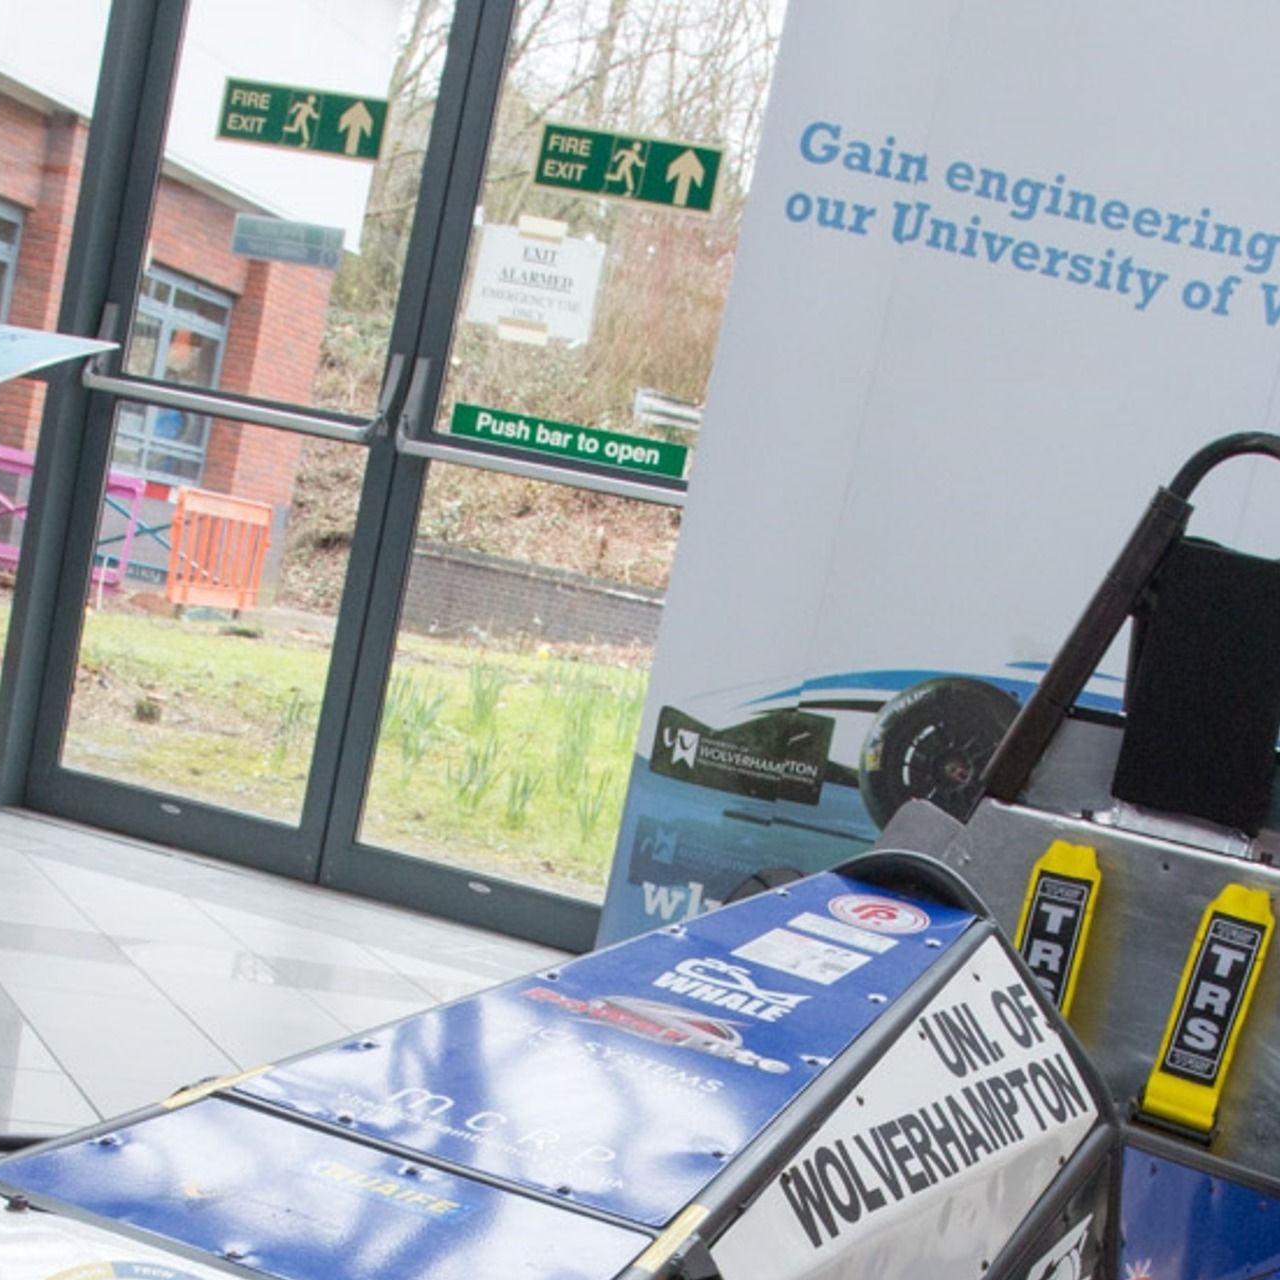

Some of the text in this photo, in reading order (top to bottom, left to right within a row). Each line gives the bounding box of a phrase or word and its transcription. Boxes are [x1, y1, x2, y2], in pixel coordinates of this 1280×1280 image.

[226, 112, 267, 135] EXIT
[231, 88, 272, 111] FIRE
[542, 158, 588, 183] EXIT
[547, 133, 593, 159] FIRE
[799, 120, 929, 188] Gain
[499, 266, 574, 290] ALARMED
[522, 246, 558, 265] EXIT
[784, 189, 878, 236] our
[890, 200, 1169, 312] University
[1181, 273, 1243, 317] of
[475, 411, 661, 466] Push bar to open
[652, 970, 797, 1024] WHALE
[990, 983, 1046, 1051] OF
[1182, 942, 1247, 1051] TRS
[778, 1052, 1090, 1250] WOLVERHAMPTON
